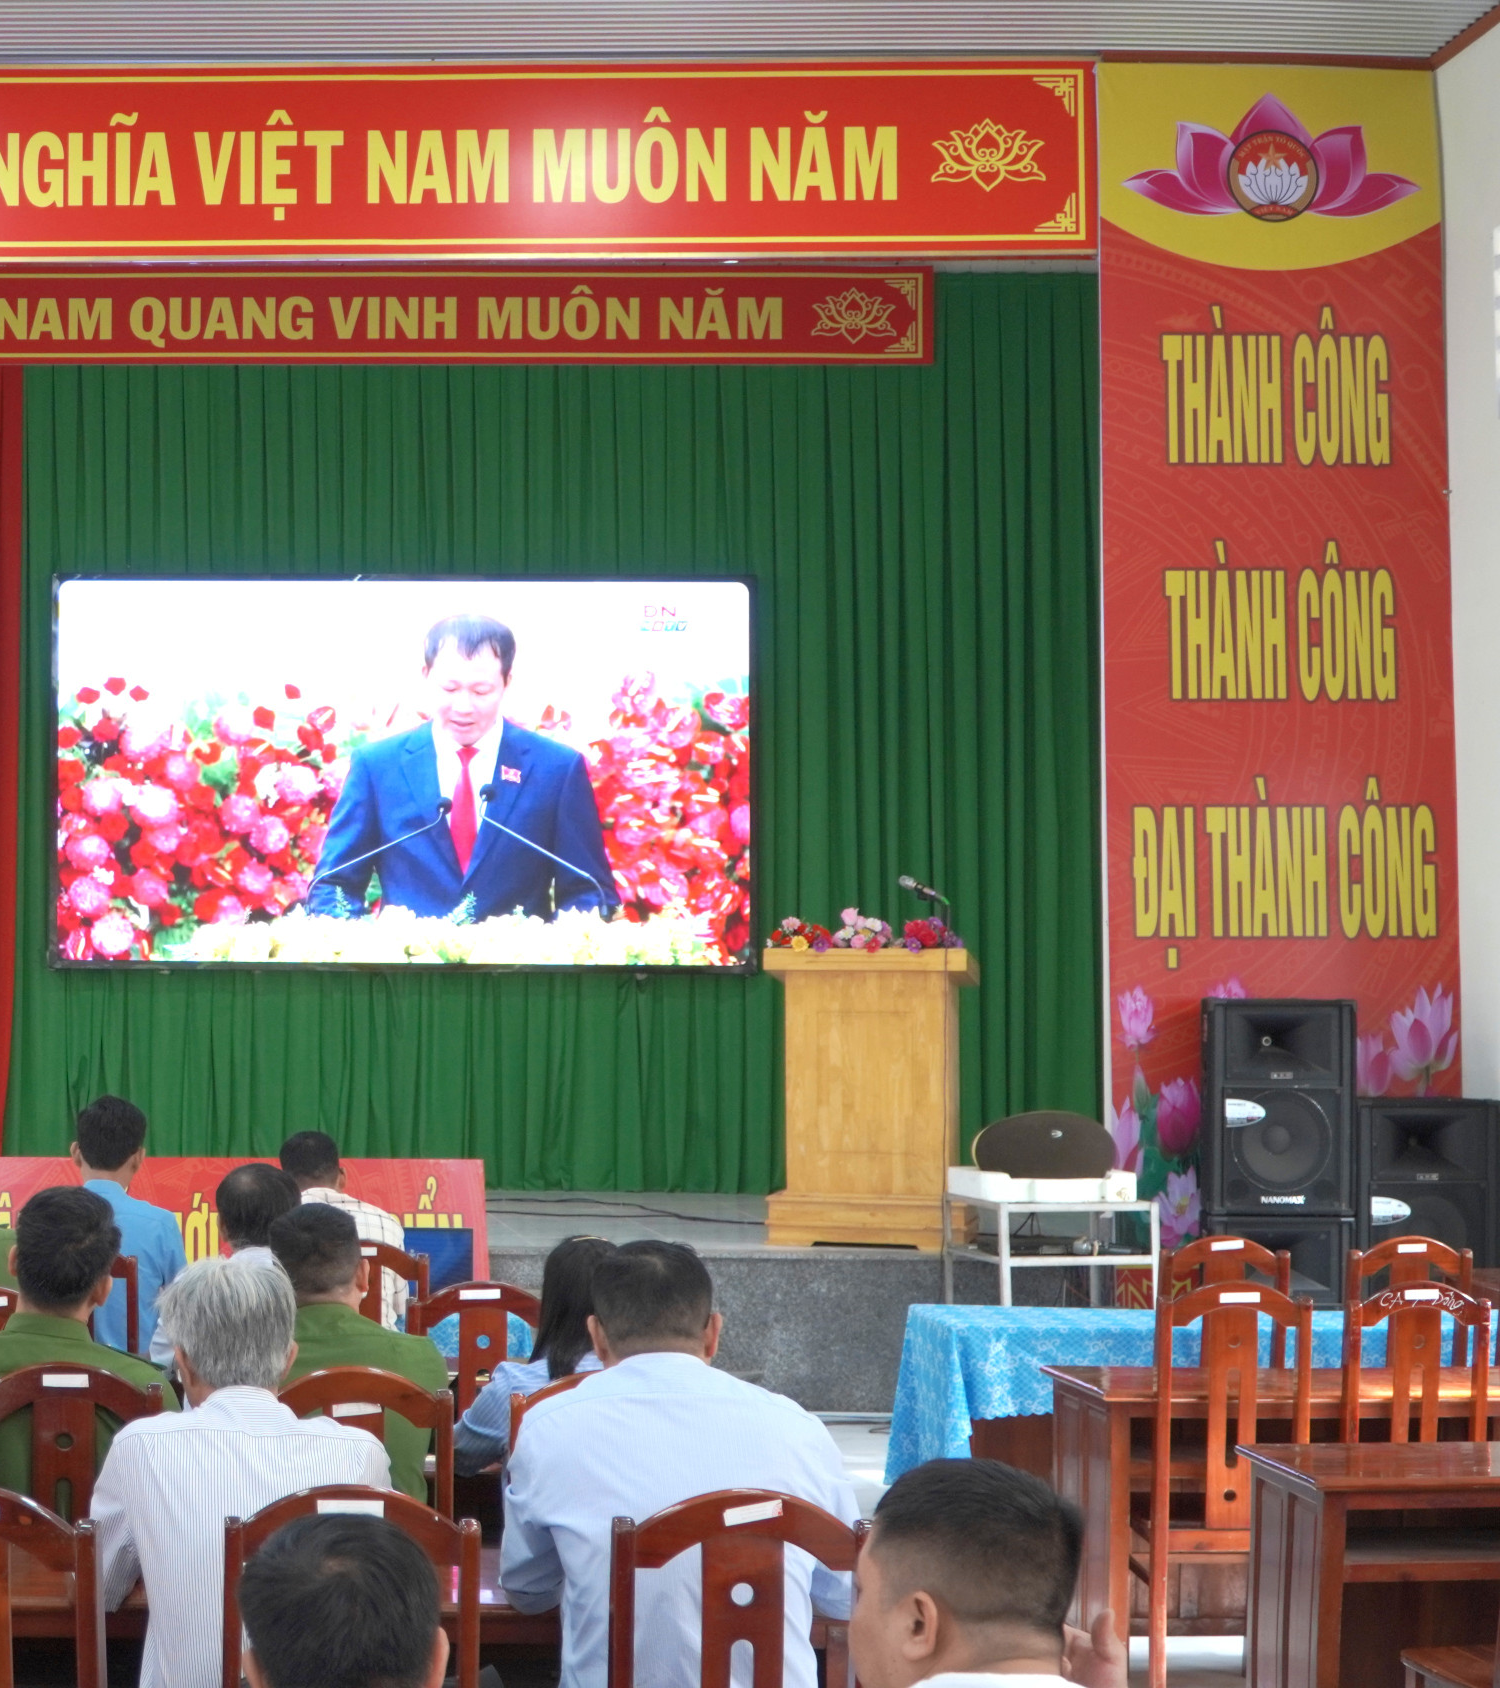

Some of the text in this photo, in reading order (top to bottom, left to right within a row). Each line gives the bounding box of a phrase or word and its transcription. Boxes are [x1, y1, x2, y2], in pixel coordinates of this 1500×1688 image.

[193, 109, 344, 222] VIỆT
[365, 128, 510, 206] NAM
[532, 106, 728, 204] MUÔN
[748, 110, 898, 202] NĂM
[129, 296, 313, 348] QUANG
[329, 297, 457, 339] VINH
[478, 285, 640, 340] MUÔN
[659, 288, 782, 339] NĂM
[1162, 306, 1390, 465] THÀNH CÔNG
[1165, 541, 1395, 701] THÀNH CÔNG
[1132, 778, 1437, 969] ĐẠI THÀNH CÔNG
[1261, 1195, 1305, 1205] NANOMAX
